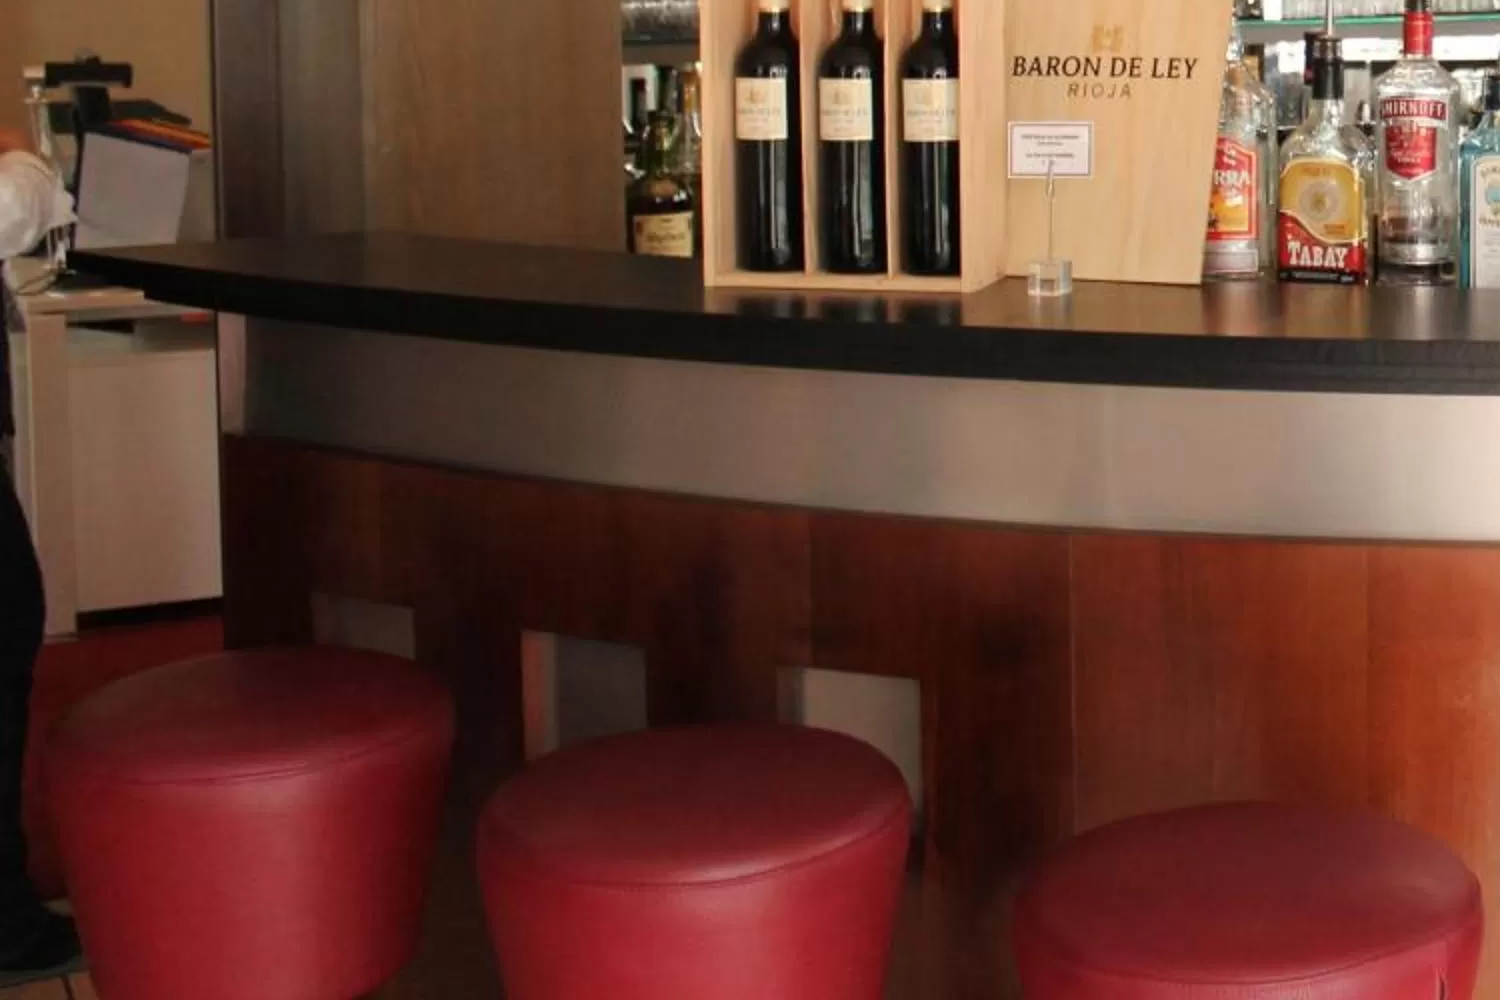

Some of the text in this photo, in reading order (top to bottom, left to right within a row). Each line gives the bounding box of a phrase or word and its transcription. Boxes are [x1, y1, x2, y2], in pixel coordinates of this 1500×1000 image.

[1012, 55, 1198, 79] BARON DE LEY
[1067, 82, 1132, 99] RIOJA
[1381, 101, 1443, 117] MIRNOFF
[1288, 242, 1349, 268] TABAY
